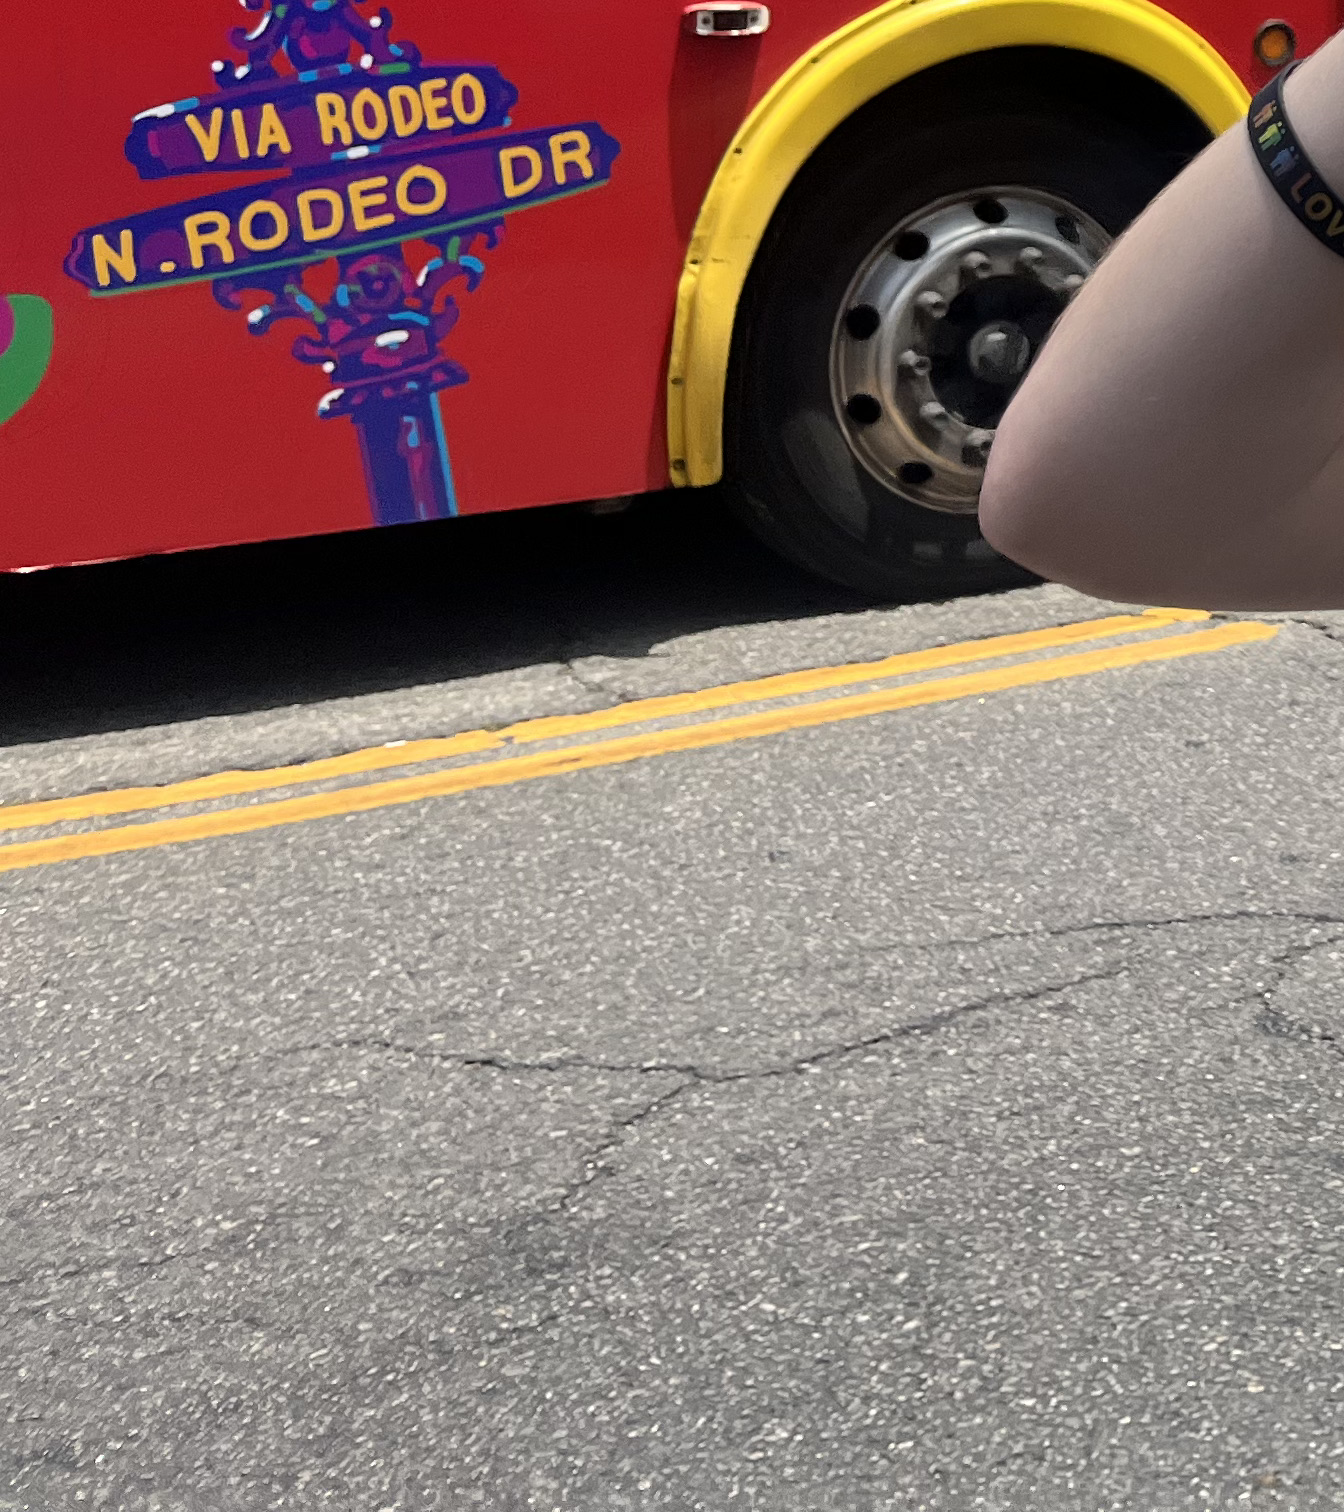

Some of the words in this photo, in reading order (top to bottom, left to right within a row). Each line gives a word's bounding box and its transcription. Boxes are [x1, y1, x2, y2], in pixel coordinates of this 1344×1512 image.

[185, 103, 292, 162] VIA
[315, 73, 487, 147] RODEO
[499, 129, 594, 199] DR
